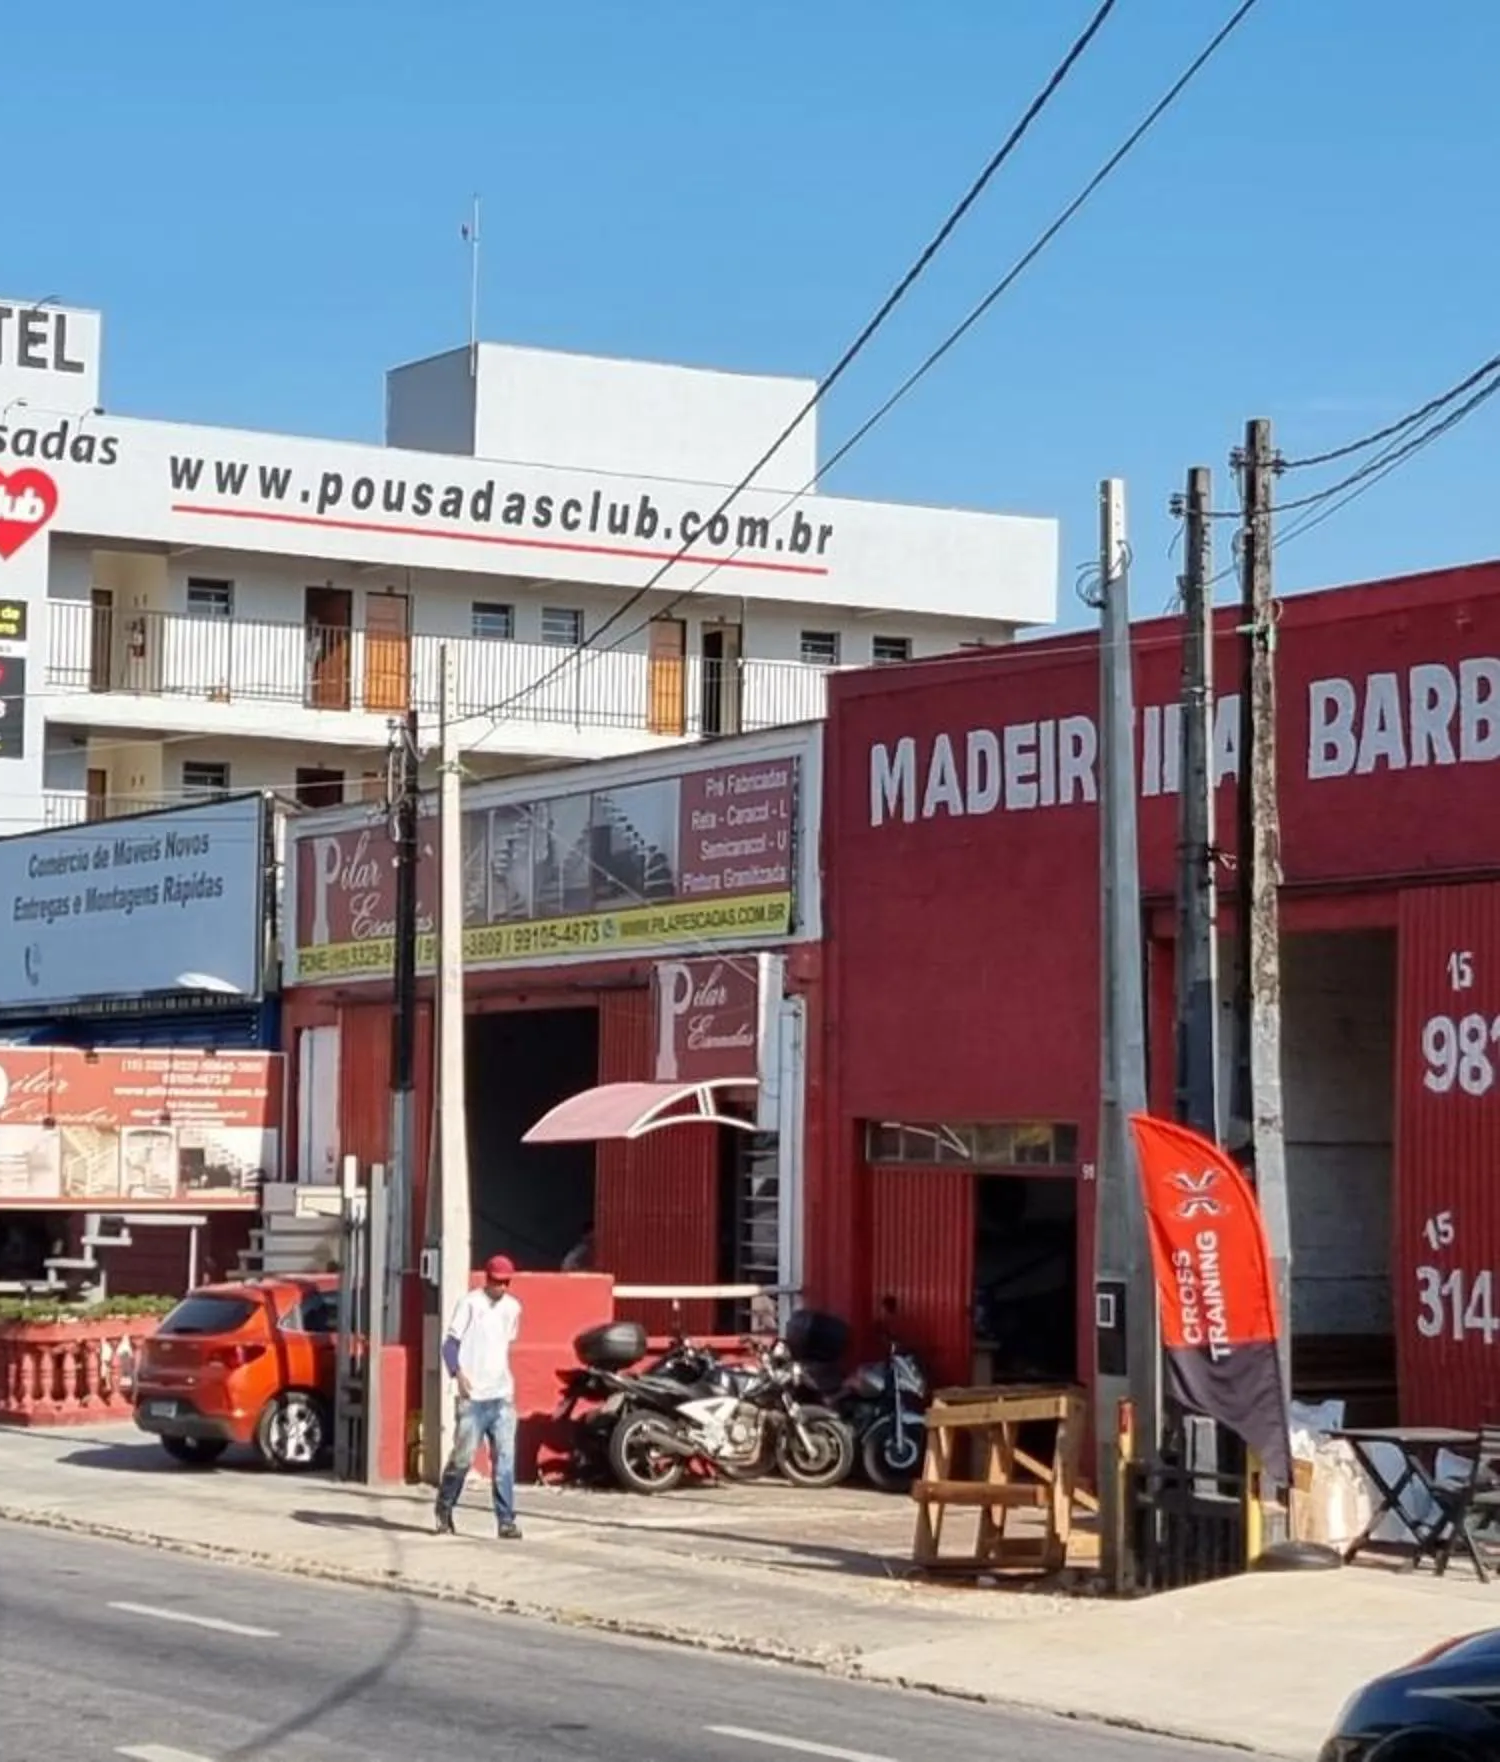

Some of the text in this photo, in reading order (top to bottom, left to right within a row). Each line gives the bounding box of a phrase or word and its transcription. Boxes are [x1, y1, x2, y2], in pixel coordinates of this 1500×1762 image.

[169, 454, 835, 556] www.pousadasclub.com.br
[1, 606, 21, 620] de
[28, 847, 90, 880] Comércio
[92, 844, 110, 869] de
[164, 831, 211, 858] Novos
[13, 871, 225, 924] Entregas e Montagens Rápidas
[312, 830, 382, 948] Pilar
[1446, 951, 1475, 992] 15
[1422, 1210, 1456, 1251] 15
[1172, 1248, 1203, 1345] CROSS
[1195, 1230, 1231, 1363] TRAINING
[1416, 1265, 1500, 1345] 314
